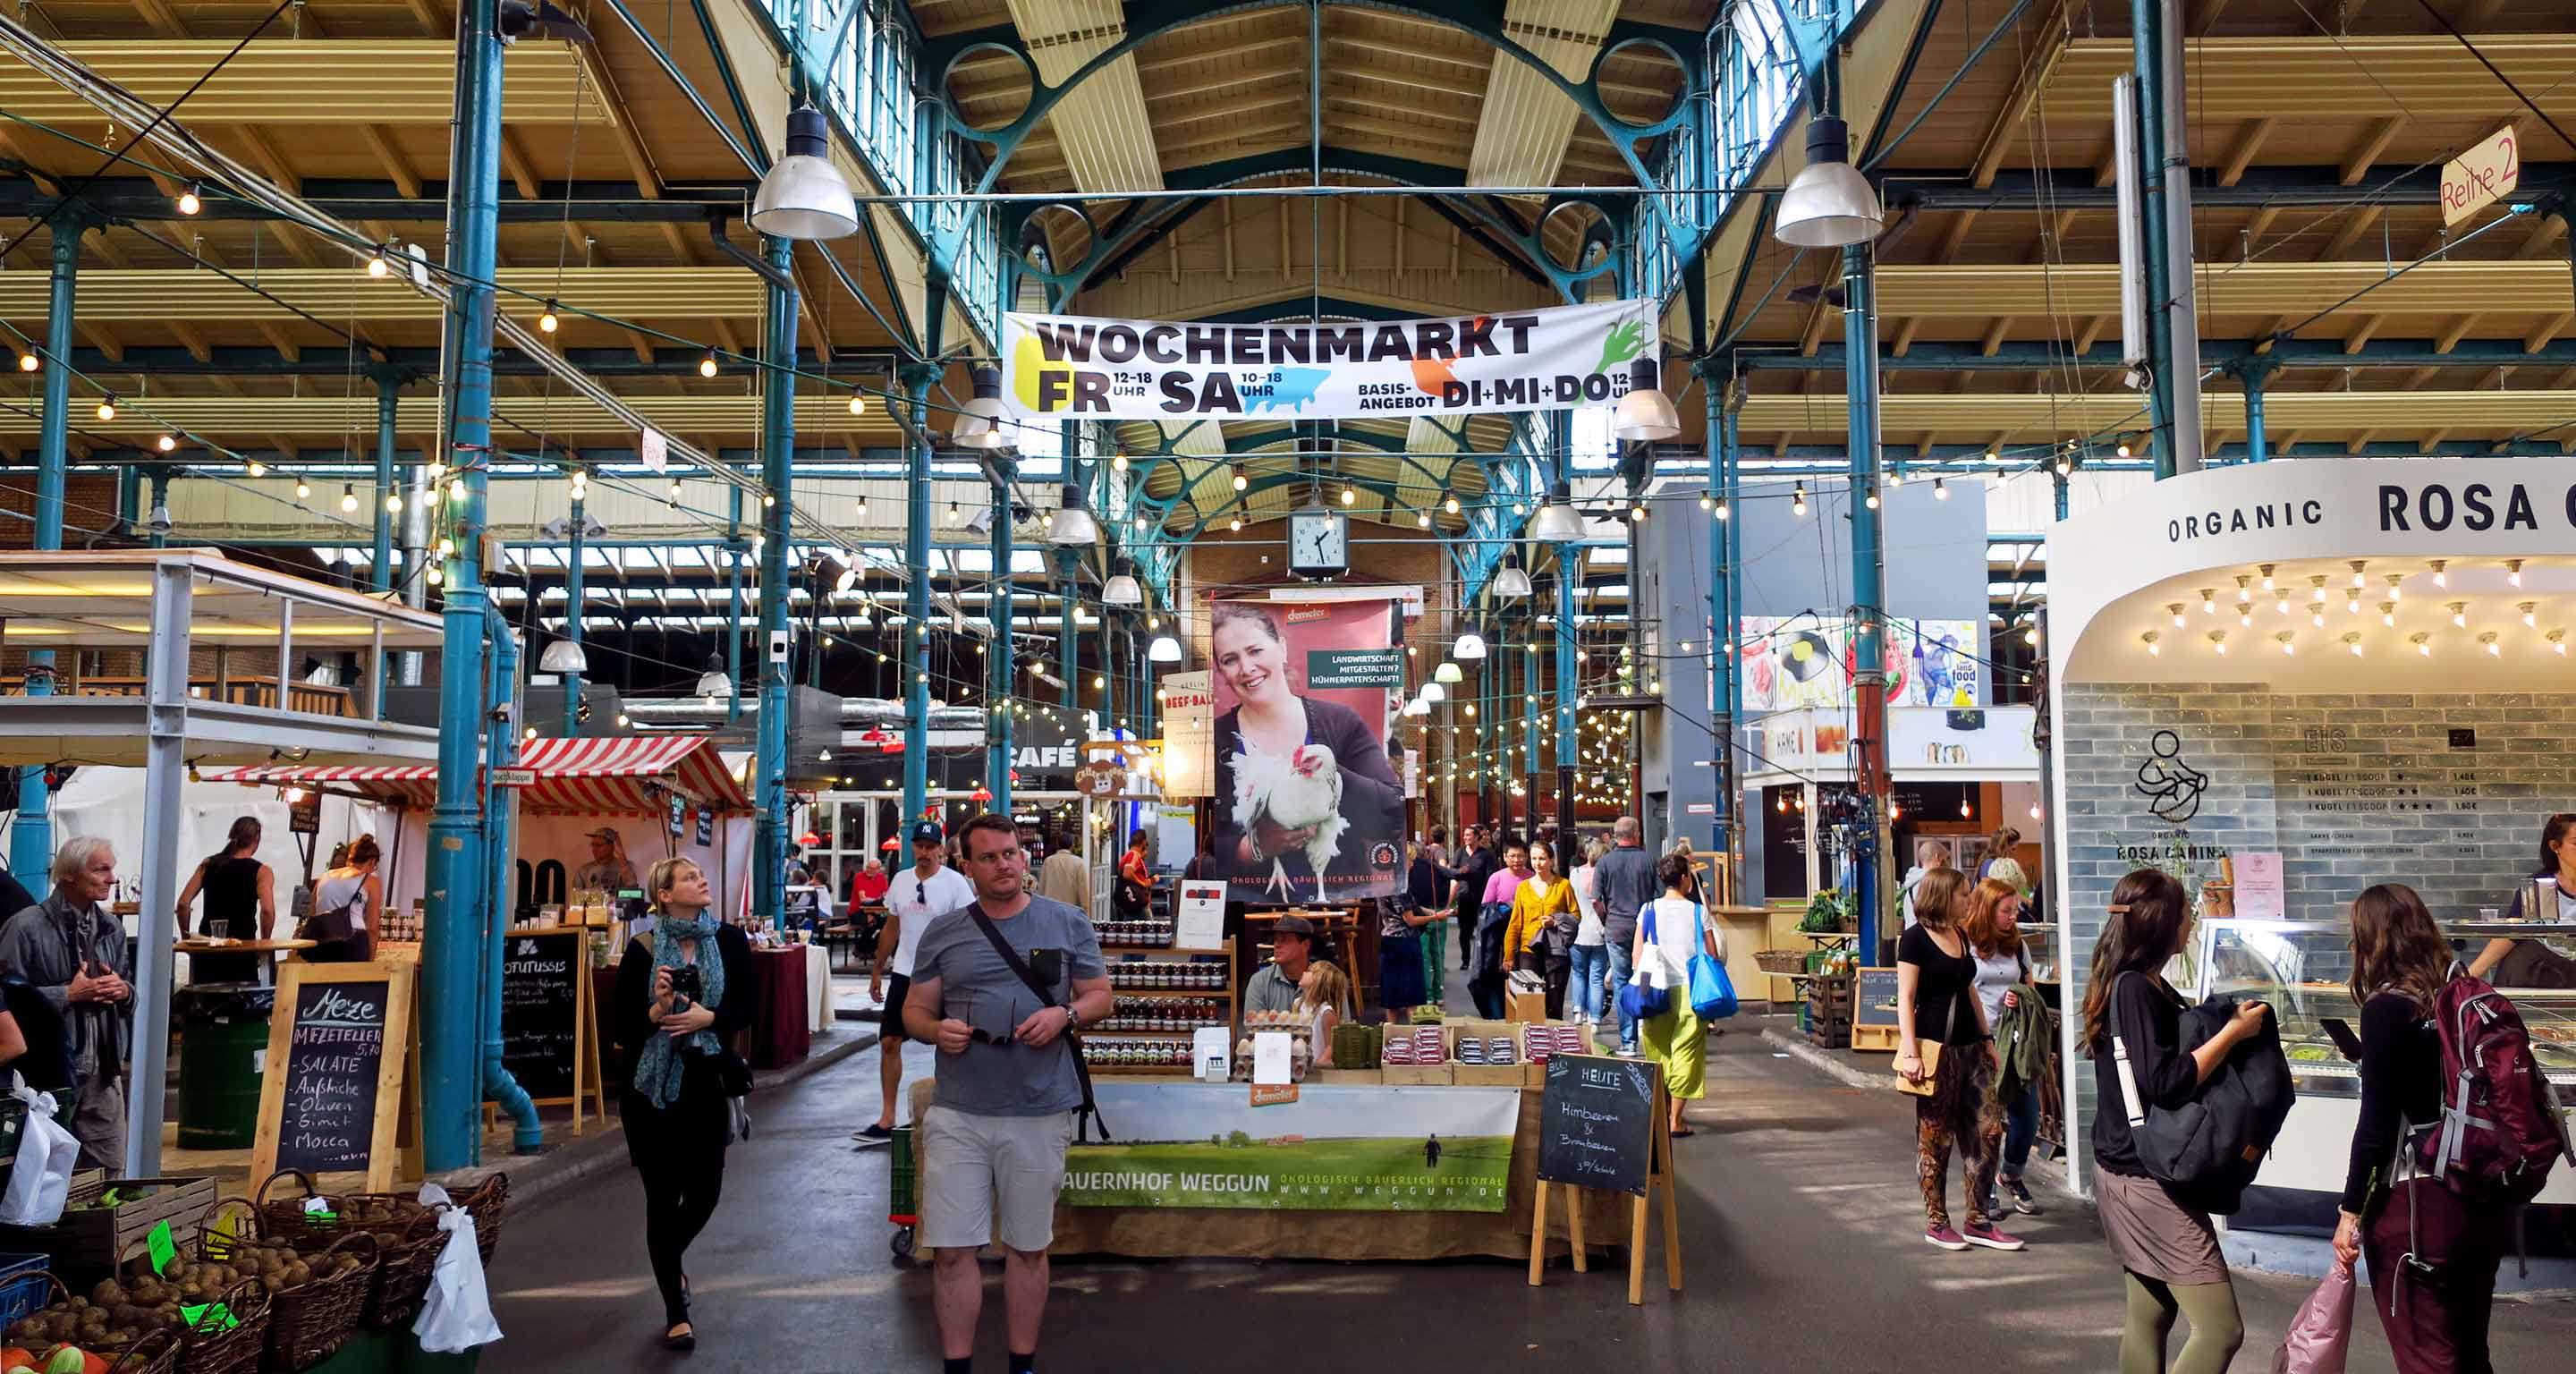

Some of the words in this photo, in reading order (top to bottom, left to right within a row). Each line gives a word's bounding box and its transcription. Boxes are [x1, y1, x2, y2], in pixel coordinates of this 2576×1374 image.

[2442, 167, 2495, 216] Reihe
[2497, 137, 2518, 182] 2
[1036, 316, 1538, 365] WOCHENMARKT
[1114, 372, 1152, 384] 12-18
[1241, 372, 1283, 383] 10-18
[1612, 373, 1632, 385] 12-
[1038, 370, 1111, 412] FR
[1113, 386, 1146, 396] UHR
[1159, 371, 1242, 413] SA
[1241, 385, 1274, 396] UHR
[1359, 383, 1411, 395] BASIS-
[1443, 372, 1611, 408] DI+MI+DO
[1359, 396, 1436, 410] ANGEBOT
[2168, 499, 2322, 543] ORGANIC
[2378, 484, 2538, 531] ROSA
[1288, 608, 1325, 620] demeter
[1332, 654, 1399, 664] LANDWIRTSCHAFT
[1339, 665, 1399, 674] MITGESTALTEN?
[1311, 674, 1399, 684] HÜHNERPATENSCHAFT!
[1953, 670, 1976, 682] food
[2304, 729, 2347, 753] EIS
[2314, 773, 2341, 782] KUGEL
[2315, 787, 2341, 796] KUGEL
[2315, 802, 2343, 810] KUGEL
[2118, 846, 2159, 860] ROSA
[300, 1056, 361, 1073] SALATE
[1581, 1067, 1622, 1086] HEUTE
[301, 1097, 352, 1112] Oliven
[295, 1132, 350, 1149] Mocca
[1062, 1172, 1174, 1192] AUERNHOF
[1181, 1172, 1270, 1192] WEGGUN
[1442, 1176, 1504, 1186] REGIONAL
